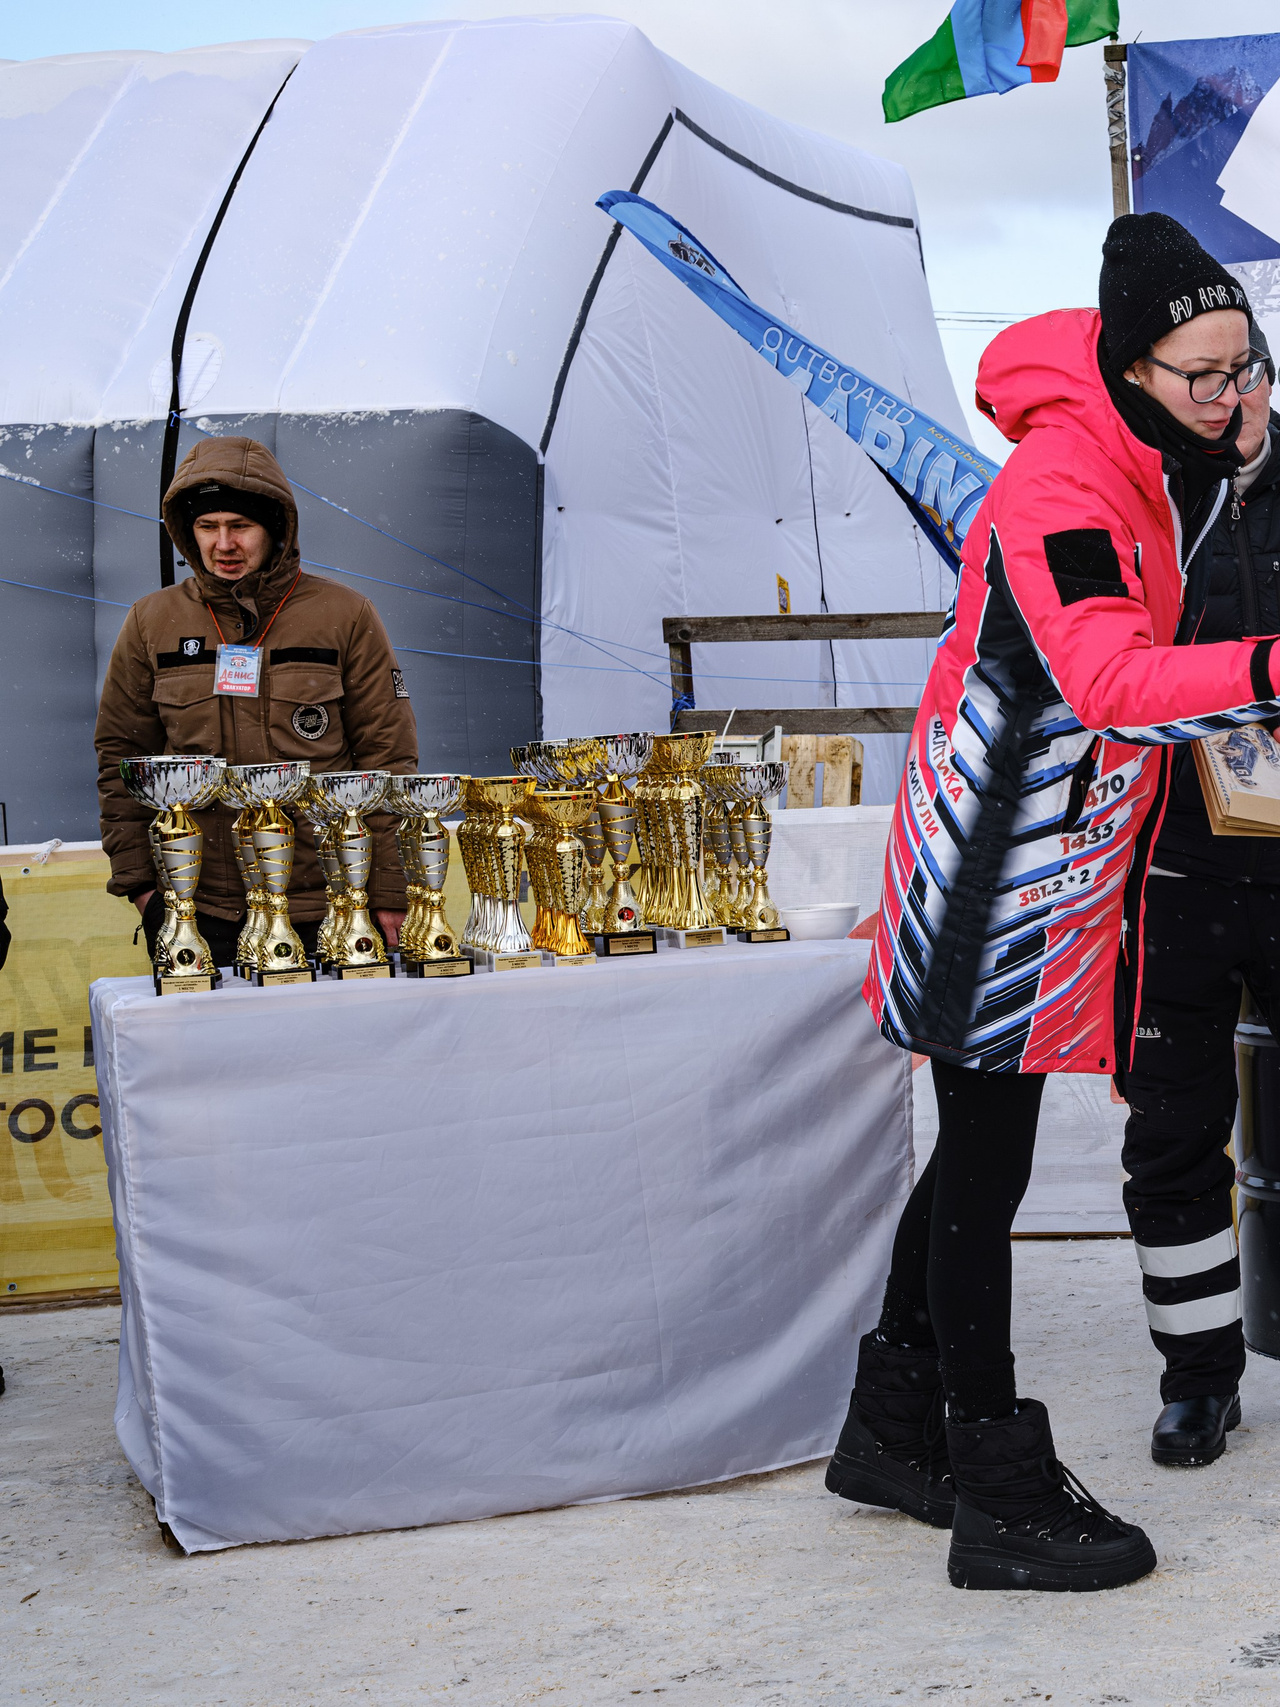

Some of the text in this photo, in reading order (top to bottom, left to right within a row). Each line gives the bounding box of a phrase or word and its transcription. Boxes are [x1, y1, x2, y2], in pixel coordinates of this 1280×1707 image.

[1169, 295, 1193, 324] BAD
[1198, 284, 1231, 310] HAIR
[763, 326, 915, 426] OUTBOARD
[219, 669, 254, 682] ДЕНИС
[1084, 774, 1125, 809] 470
[1080, 869, 1091, 884] 2
